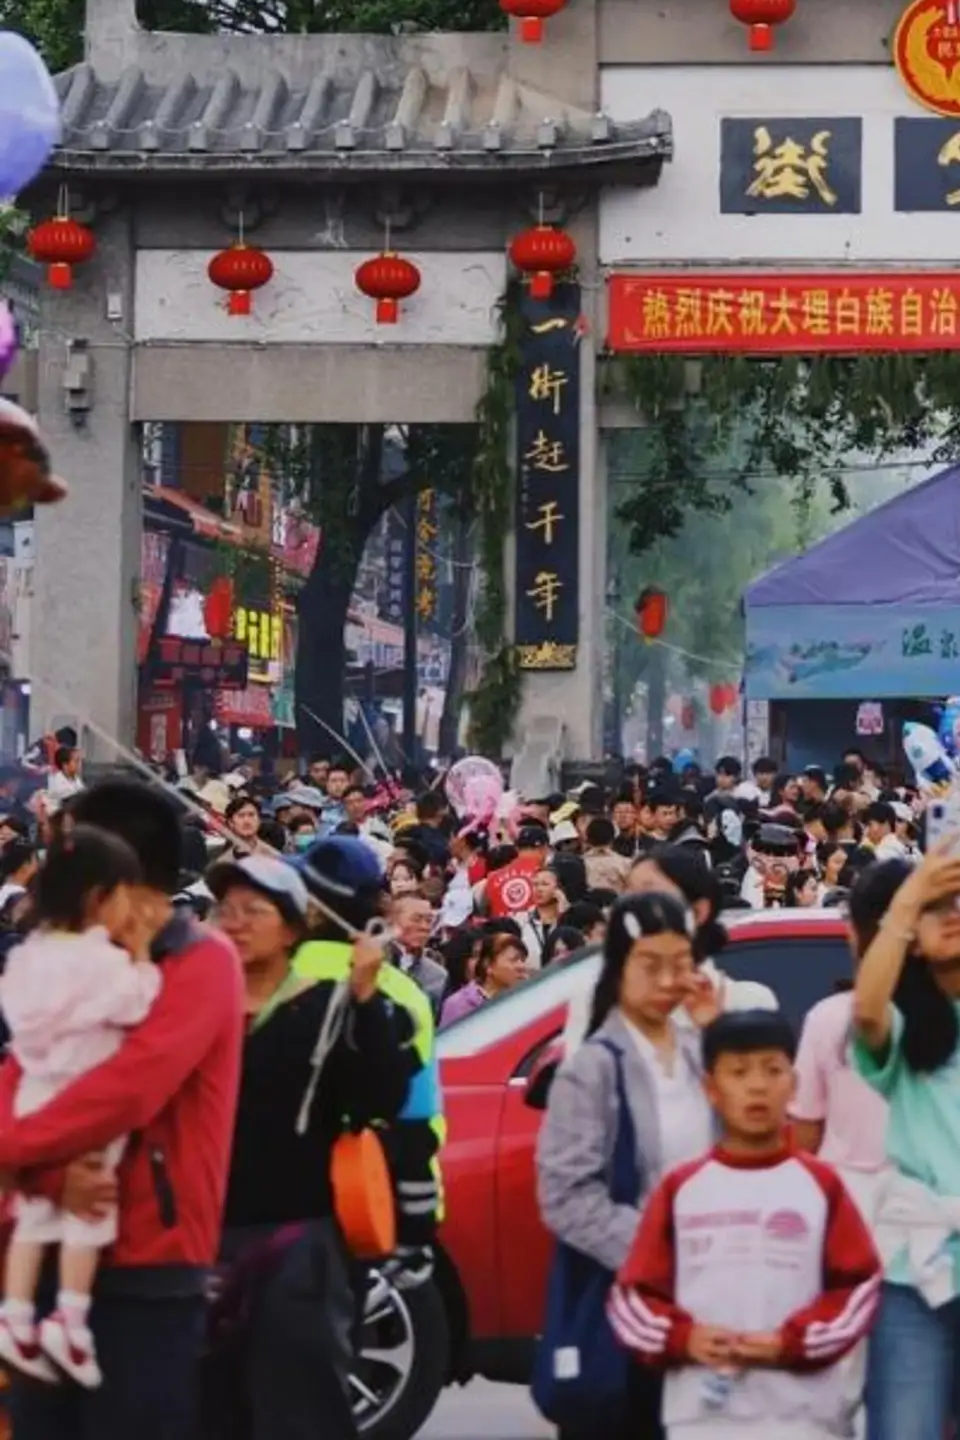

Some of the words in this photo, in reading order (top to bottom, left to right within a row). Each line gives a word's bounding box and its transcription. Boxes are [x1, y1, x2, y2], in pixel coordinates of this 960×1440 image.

[525, 316, 570, 622] 一街赶千年
